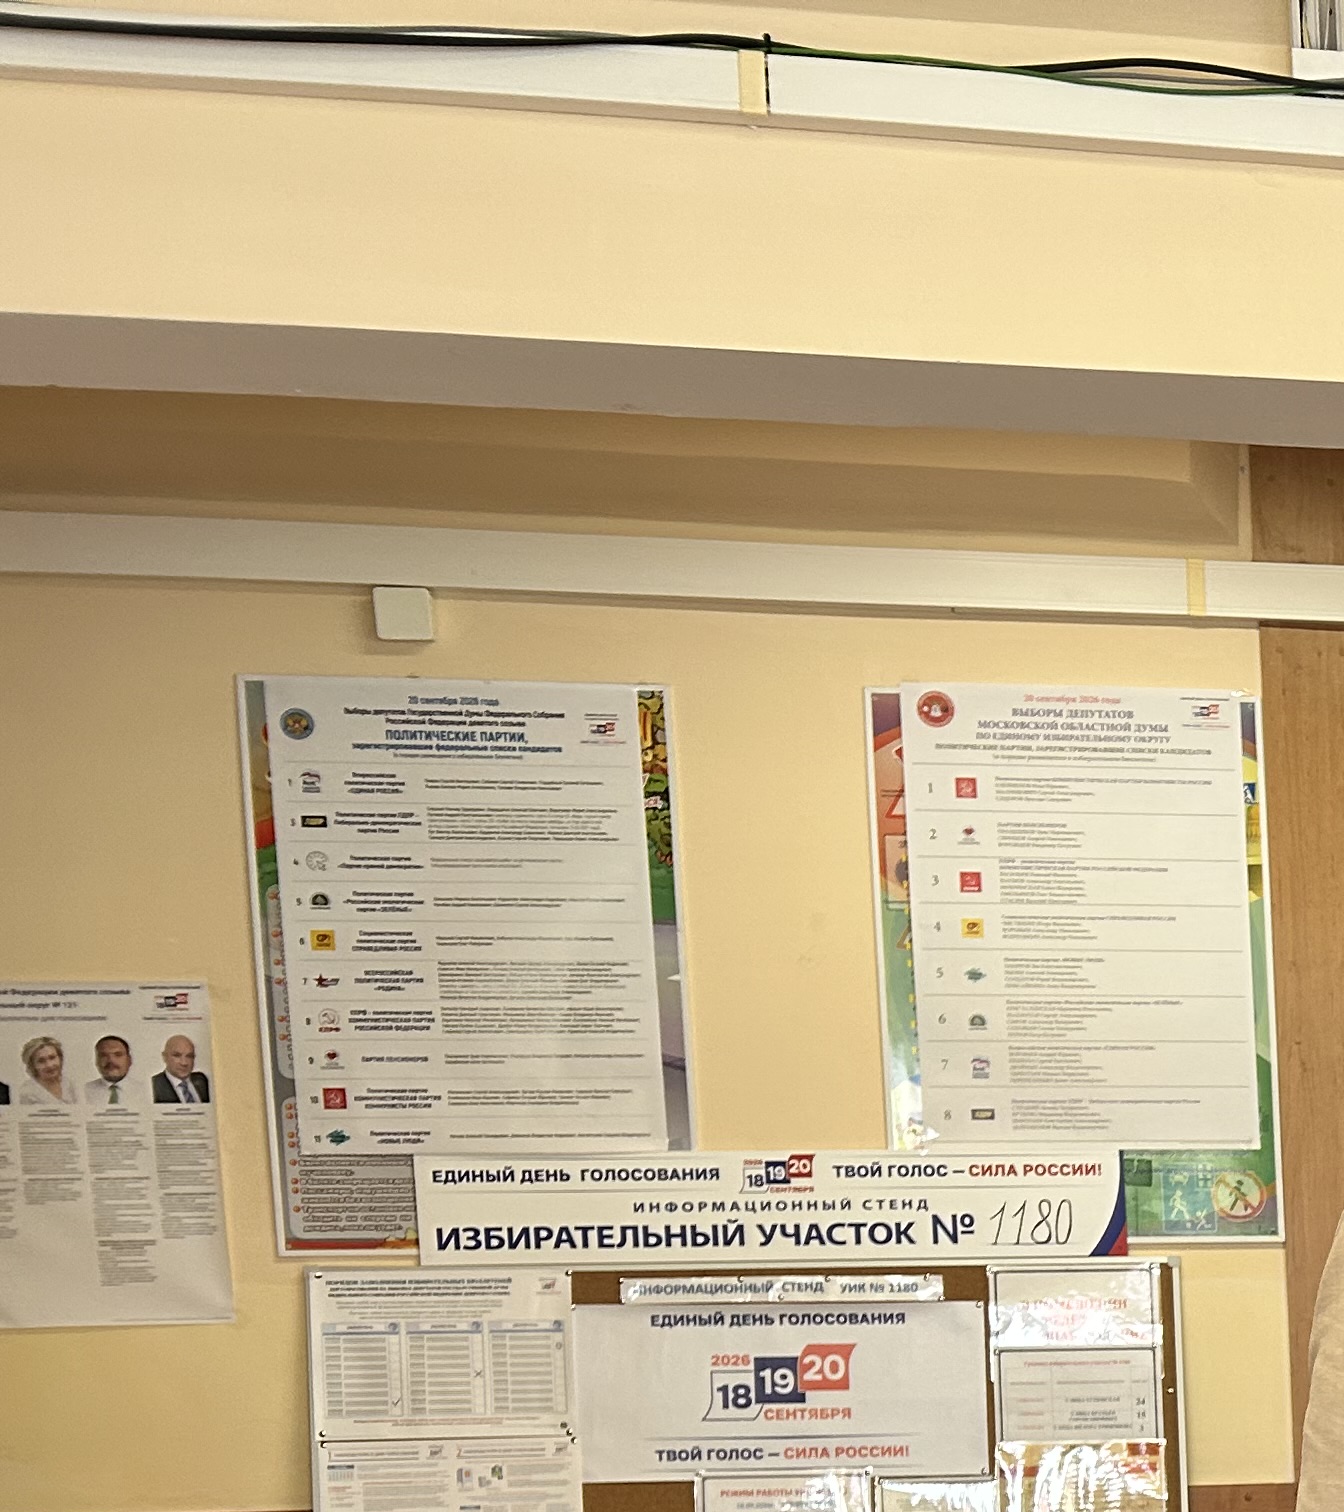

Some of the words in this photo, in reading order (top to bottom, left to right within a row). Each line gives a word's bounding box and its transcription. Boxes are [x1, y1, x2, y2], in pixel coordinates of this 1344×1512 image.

[1065, 709, 1135, 719] ДЕПУТАТОВ
[977, 719, 1059, 730] МОСКОВСКОЙ
[1060, 721, 1132, 732] ОБЛАСТНОЙ
[385, 729, 477, 742] ПОЛИТИЧЕСКИЕ
[479, 731, 528, 745] ПАРТИИ,
[432, 1165, 515, 1184] ЕДИНЫЙ
[520, 1168, 571, 1185] ДЕНЬ
[580, 1167, 721, 1183] ГОЛОСОВАНИЯ
[746, 1174, 764, 1188] 18
[767, 1165, 786, 1181] 19
[789, 1159, 811, 1174] 20
[833, 1162, 881, 1179] ТВОЙ
[888, 1163, 948, 1178] ГОЛОС
[968, 1163, 1018, 1178] СИЛА
[1023, 1162, 1103, 1178] РОССИИ!
[633, 1197, 852, 1214] ИНФОРМАЦИОННЫЙ
[863, 1197, 930, 1212] СТЕНД
[435, 1218, 746, 1251] ИЗБИРАТЕЛЬНЫЙ
[757, 1220, 917, 1248] УЧАСТОК
[932, 1213, 976, 1245] №
[989, 1198, 1074, 1246] 1180
[781, 1281, 824, 1294] СТЕНД
[840, 1281, 866, 1295] УИК
[889, 1282, 919, 1293] 1180
[650, 1311, 725, 1327] ЕДИНЫЙ
[729, 1313, 775, 1328] ДЕНЬ
[779, 1312, 906, 1326] ГОЛОСОВАНИЯ
[710, 1353, 750, 1367] 2026
[716, 1384, 753, 1411] 18
[759, 1367, 795, 1396] 19
[802, 1355, 847, 1382] 20
[764, 1406, 852, 1421] СЕНТЯБРЯ
[655, 1446, 702, 1462] ТВОЙ
[707, 1447, 764, 1461] ГОЛОС
[783, 1446, 830, 1460] СИЛА
[835, 1445, 910, 1459] РОССИИ!
